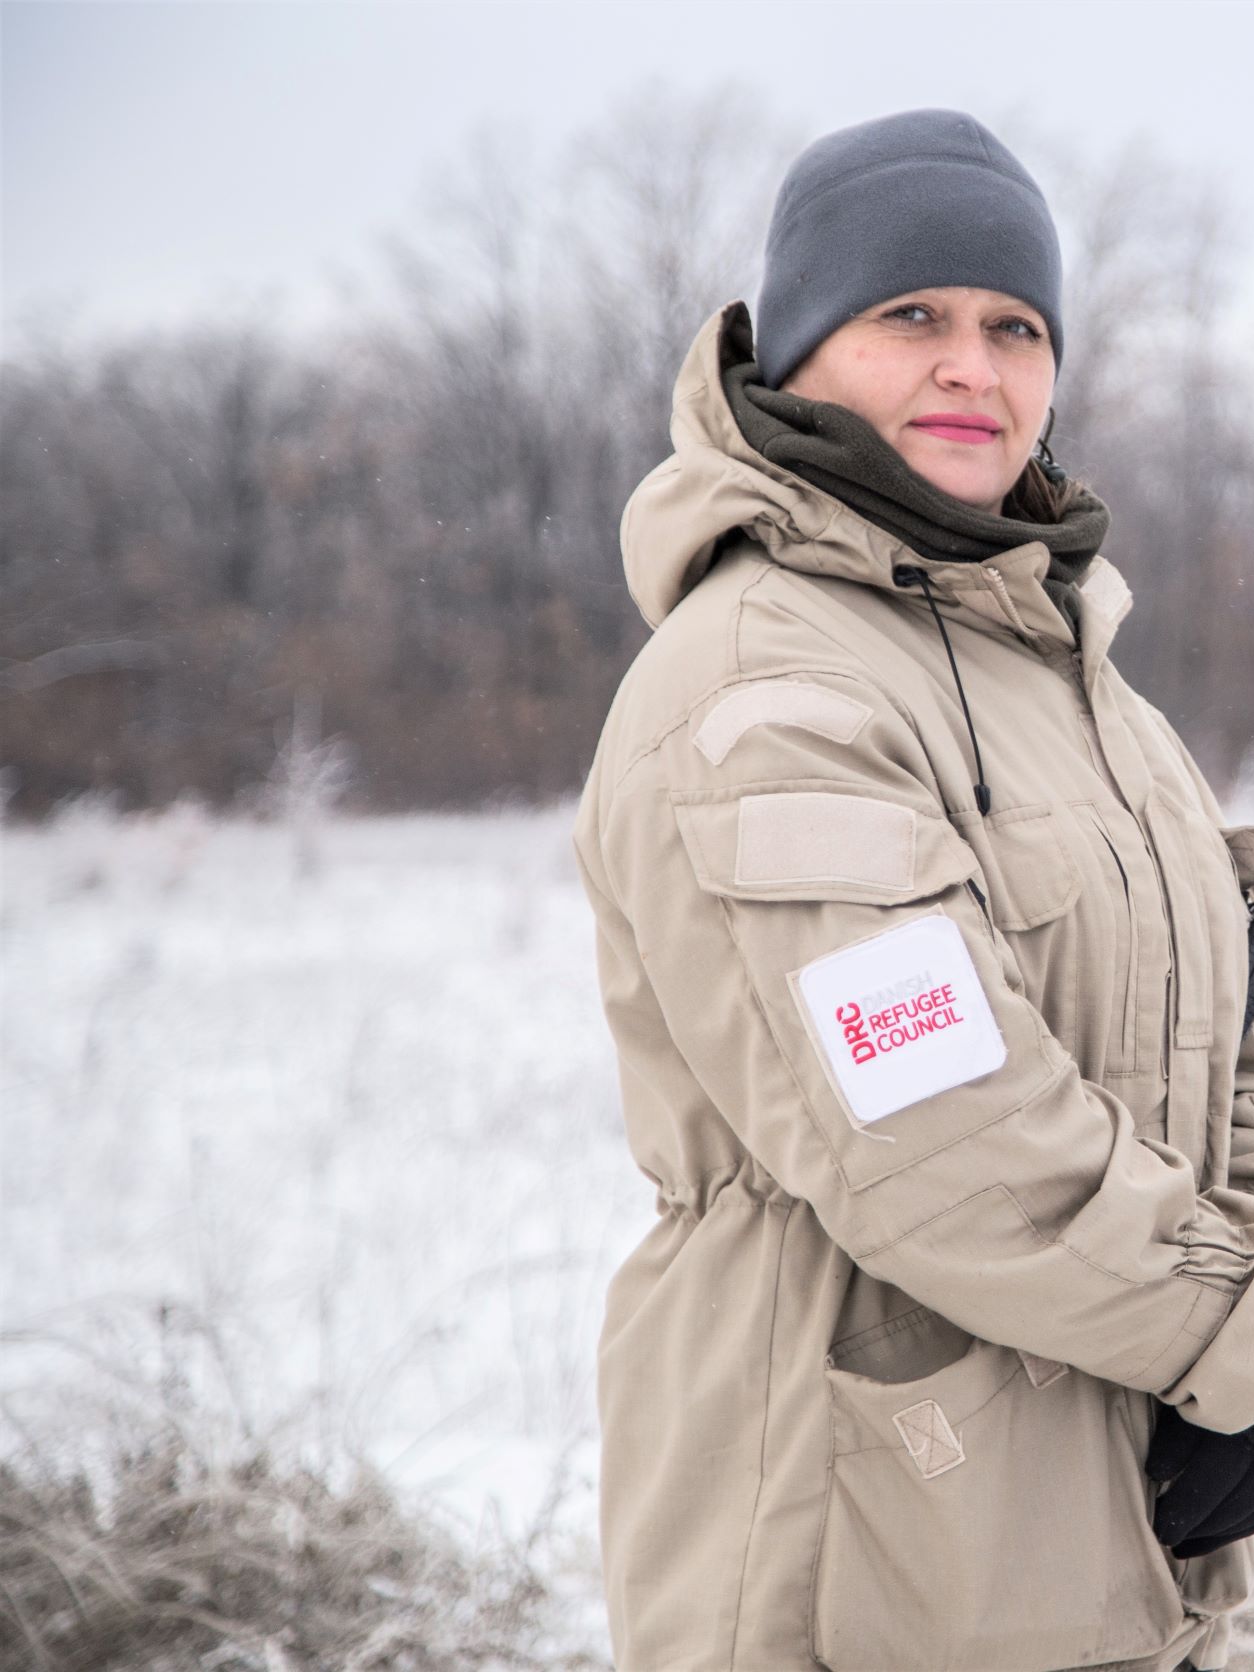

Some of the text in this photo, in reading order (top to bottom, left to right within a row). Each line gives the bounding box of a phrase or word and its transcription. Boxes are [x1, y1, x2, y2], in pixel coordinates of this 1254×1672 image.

[862, 970, 934, 1014] DANISH
[868, 984, 956, 1033] REFUGEE
[836, 1002, 877, 1065] DRC
[877, 1006, 964, 1053] COUNCIL
